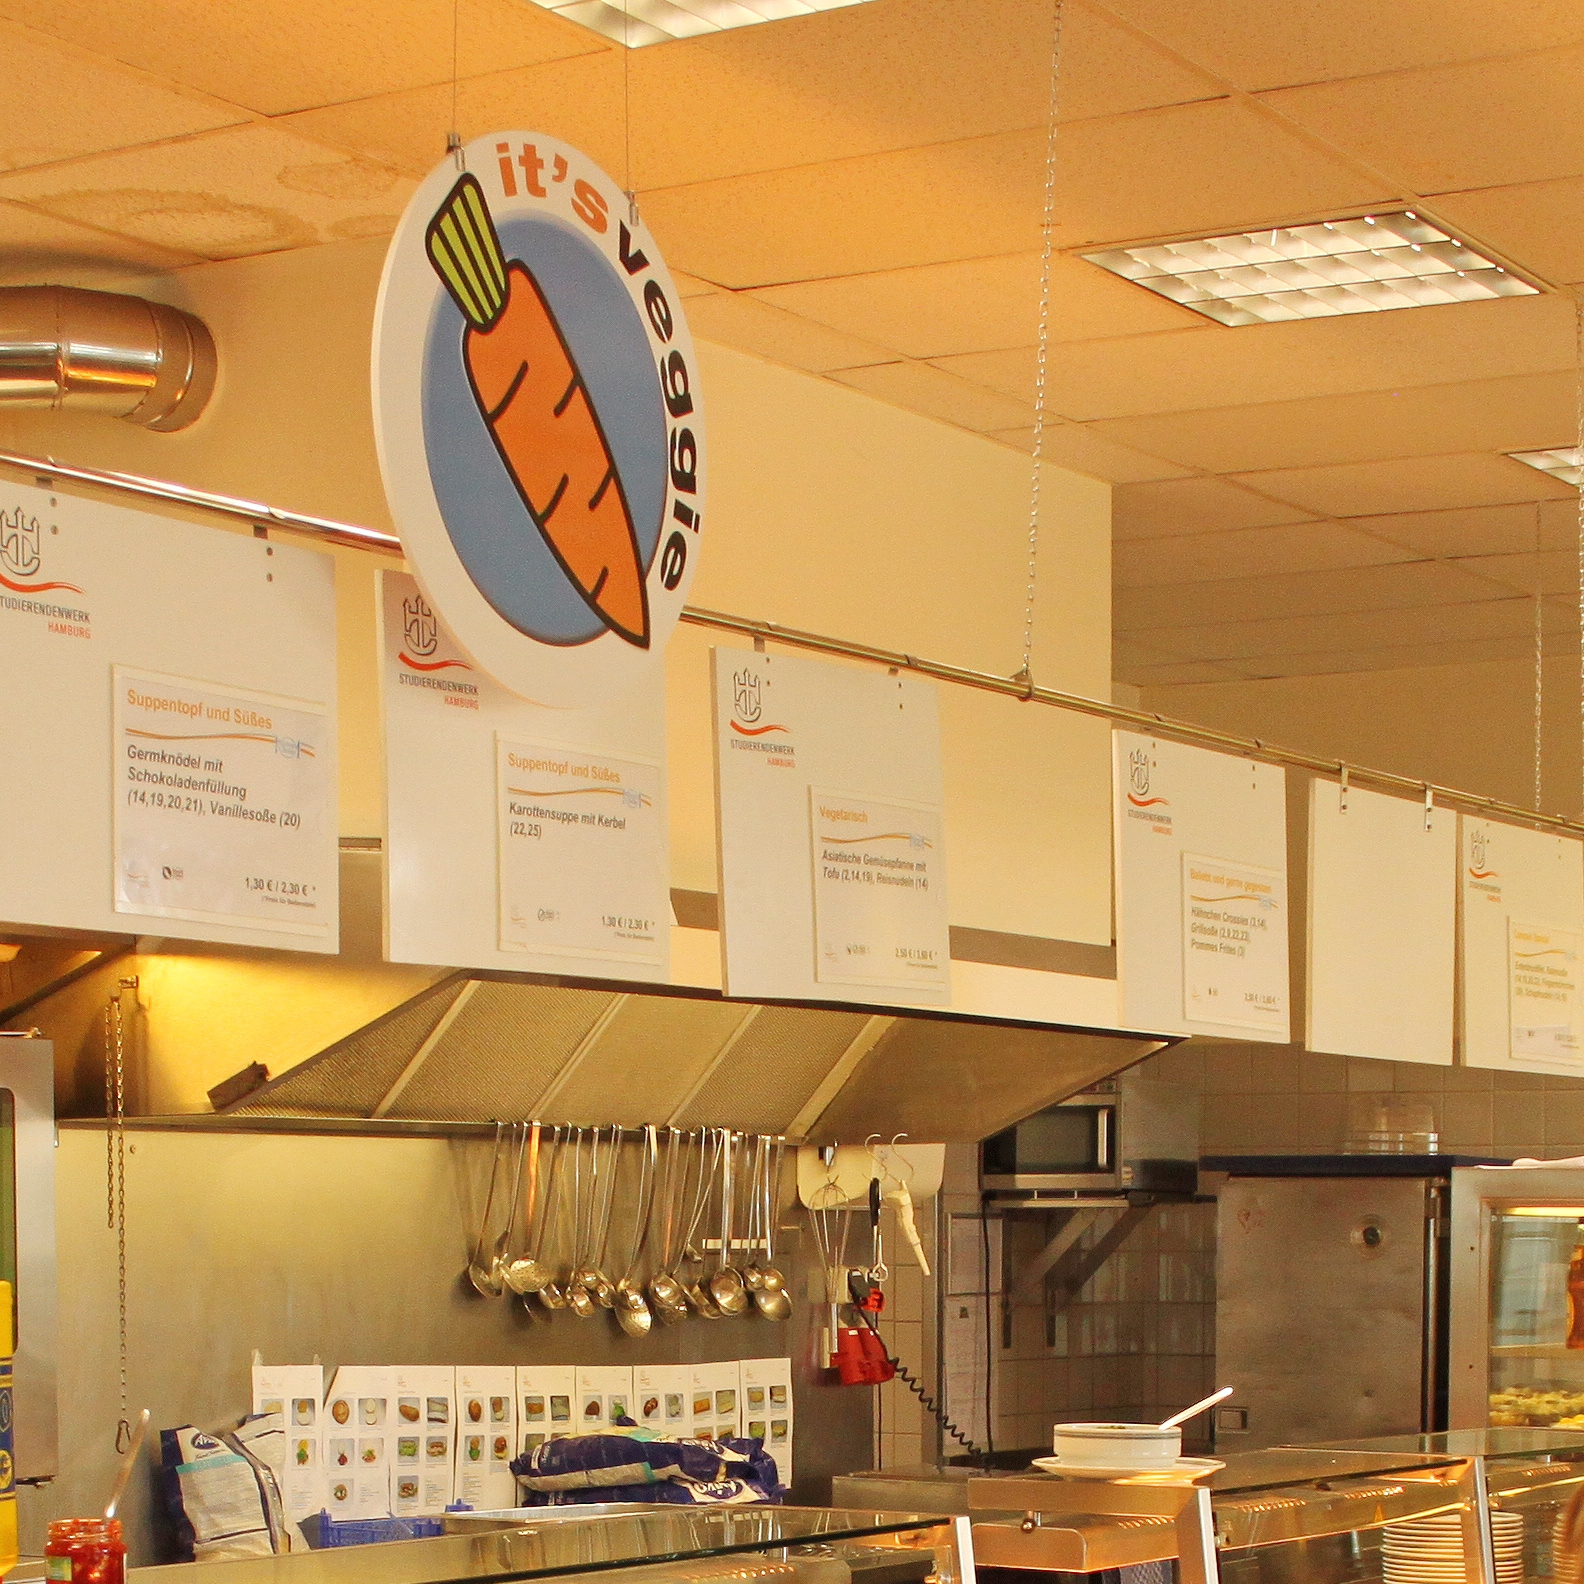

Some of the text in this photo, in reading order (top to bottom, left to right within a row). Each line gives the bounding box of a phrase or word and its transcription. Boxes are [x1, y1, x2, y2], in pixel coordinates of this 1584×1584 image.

[495, 142, 609, 235] it's
[618, 218, 700, 592] veggie
[48, 621, 91, 639] HAMBURG
[127, 689, 272, 729] Suppentopf und Süßes
[127, 744, 223, 773] Germknödel mit
[508, 753, 621, 783] Suppentopf und Süßes
[128, 766, 247, 801] Schokoladenfüllung
[210, 801, 276, 824] Vanillesoße
[279, 812, 301, 829] (20)
[509, 802, 626, 830] Karottensuppe mit Kerbel
[510, 821, 542, 840] (22,25)
[245, 877, 265, 891] 1,30
[266, 880, 273, 892] €
[302, 884, 309, 897] €
